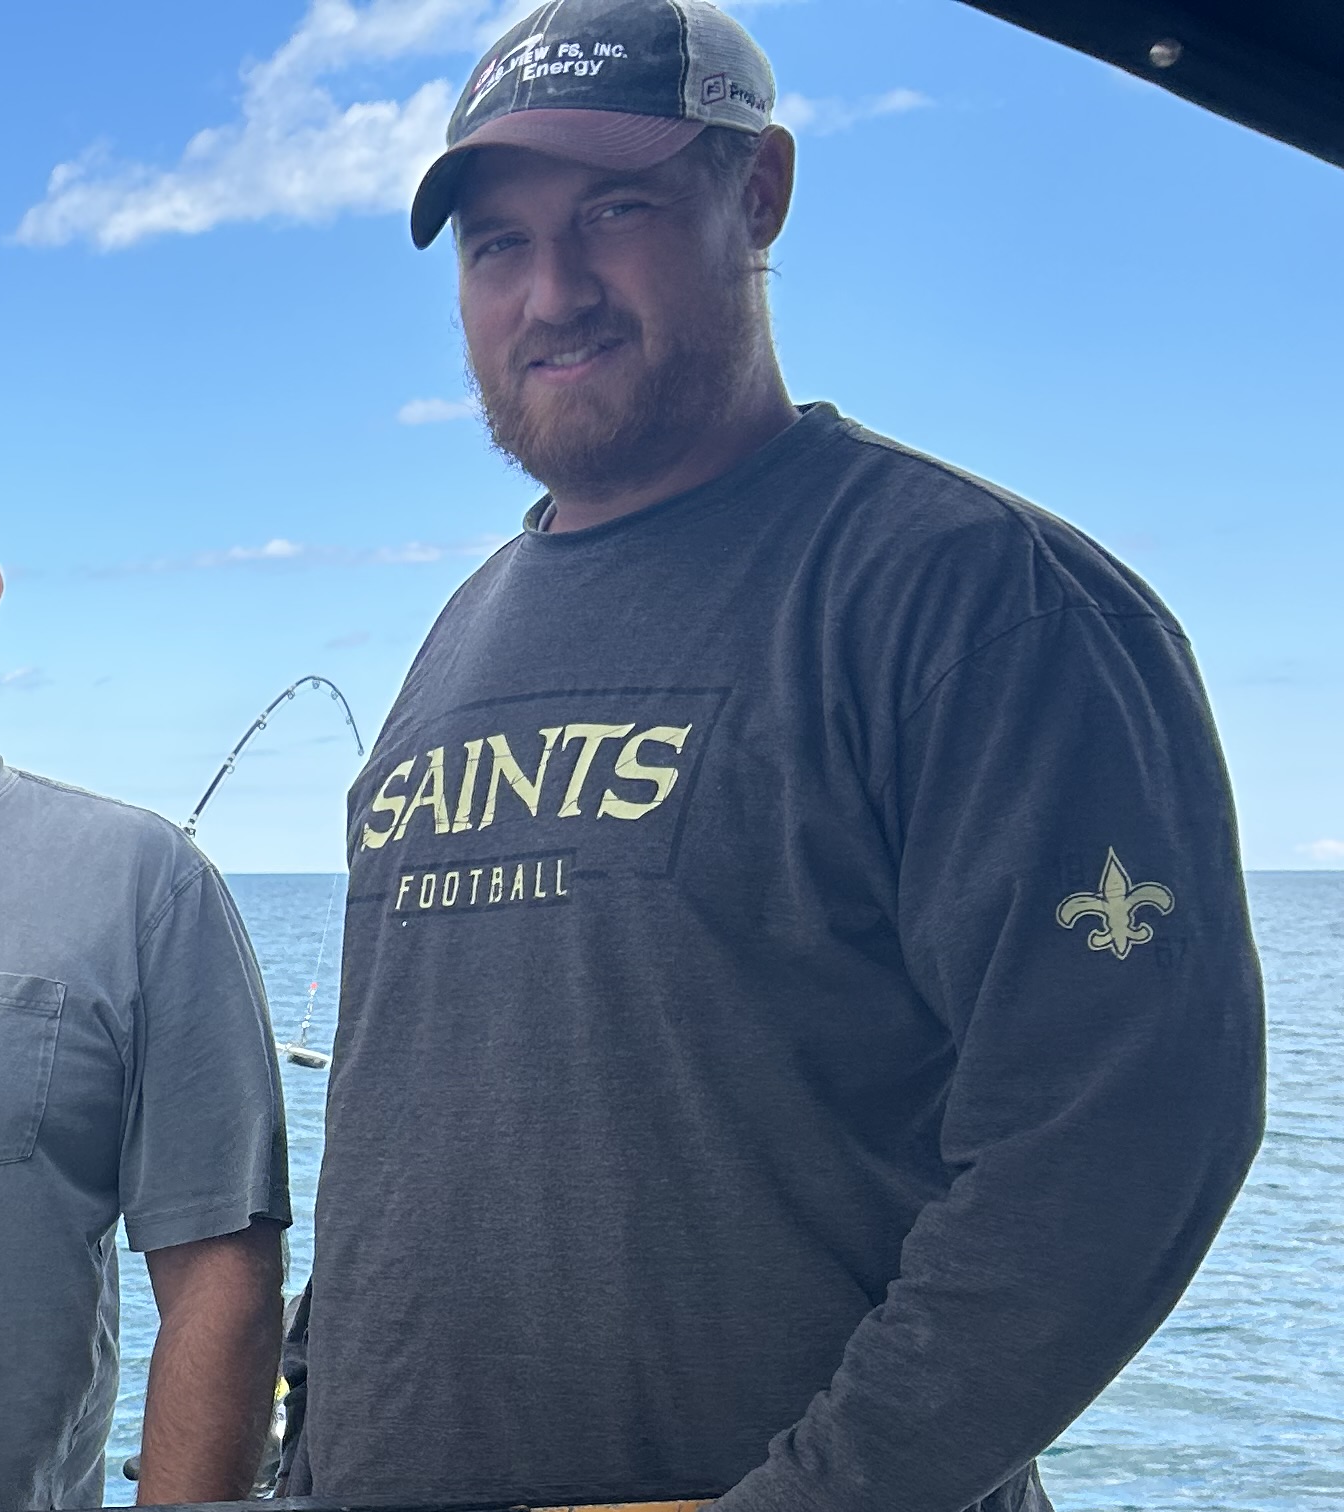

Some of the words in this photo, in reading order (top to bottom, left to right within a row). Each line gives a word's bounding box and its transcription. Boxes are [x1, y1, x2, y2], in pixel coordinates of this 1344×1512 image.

[558, 42, 584, 59] FS,
[593, 42, 628, 59] INC.
[522, 59, 605, 82] Energy
[361, 723, 692, 852] SAINTS
[395, 859, 567, 911] FOOTBALL
